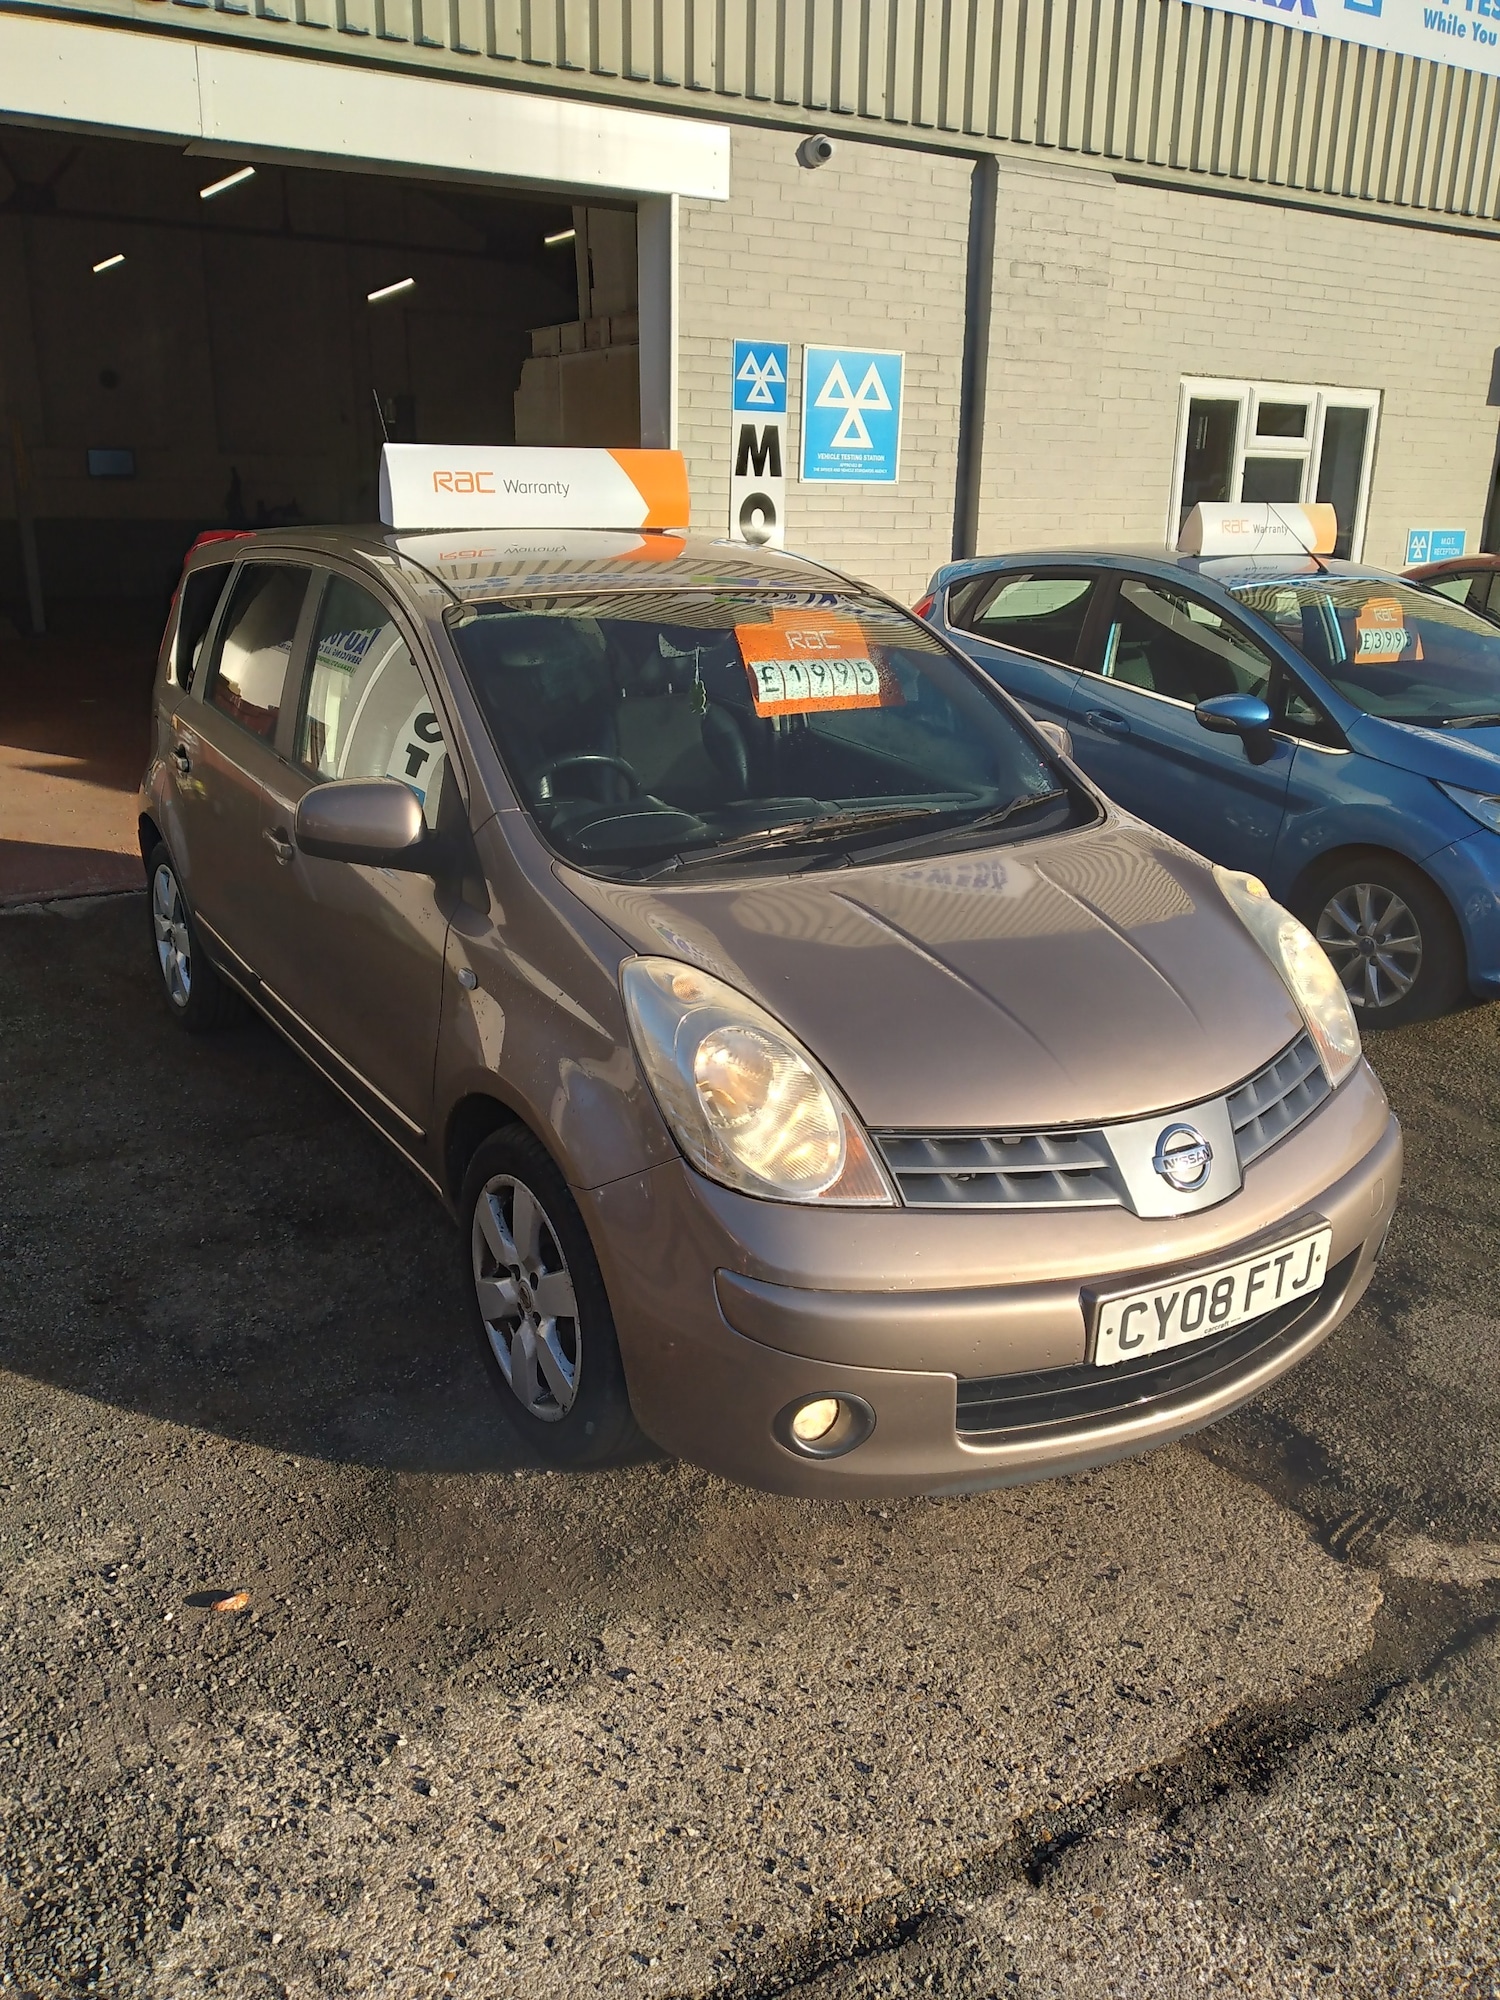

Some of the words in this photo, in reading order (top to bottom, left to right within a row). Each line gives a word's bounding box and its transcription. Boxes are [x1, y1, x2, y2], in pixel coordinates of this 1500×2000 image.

[1423, 7, 1467, 38] While
[1472, 21, 1498, 46] You
[817, 452, 840, 460] VEHICLE
[841, 453, 863, 461] TESTING
[863, 454, 885, 462] STATION
[503, 479, 570, 498] Warranty
[1253, 524, 1288, 536] Warranty
[1433, 547, 1460, 556] RECEPTION
[1363, 631, 1412, 650] £3995
[761, 662, 874, 693] £1995
[1118, 1275, 1235, 1351] CY08
[1243, 1241, 1317, 1313] FTJ
[1203, 1319, 1230, 1334] carcraft
